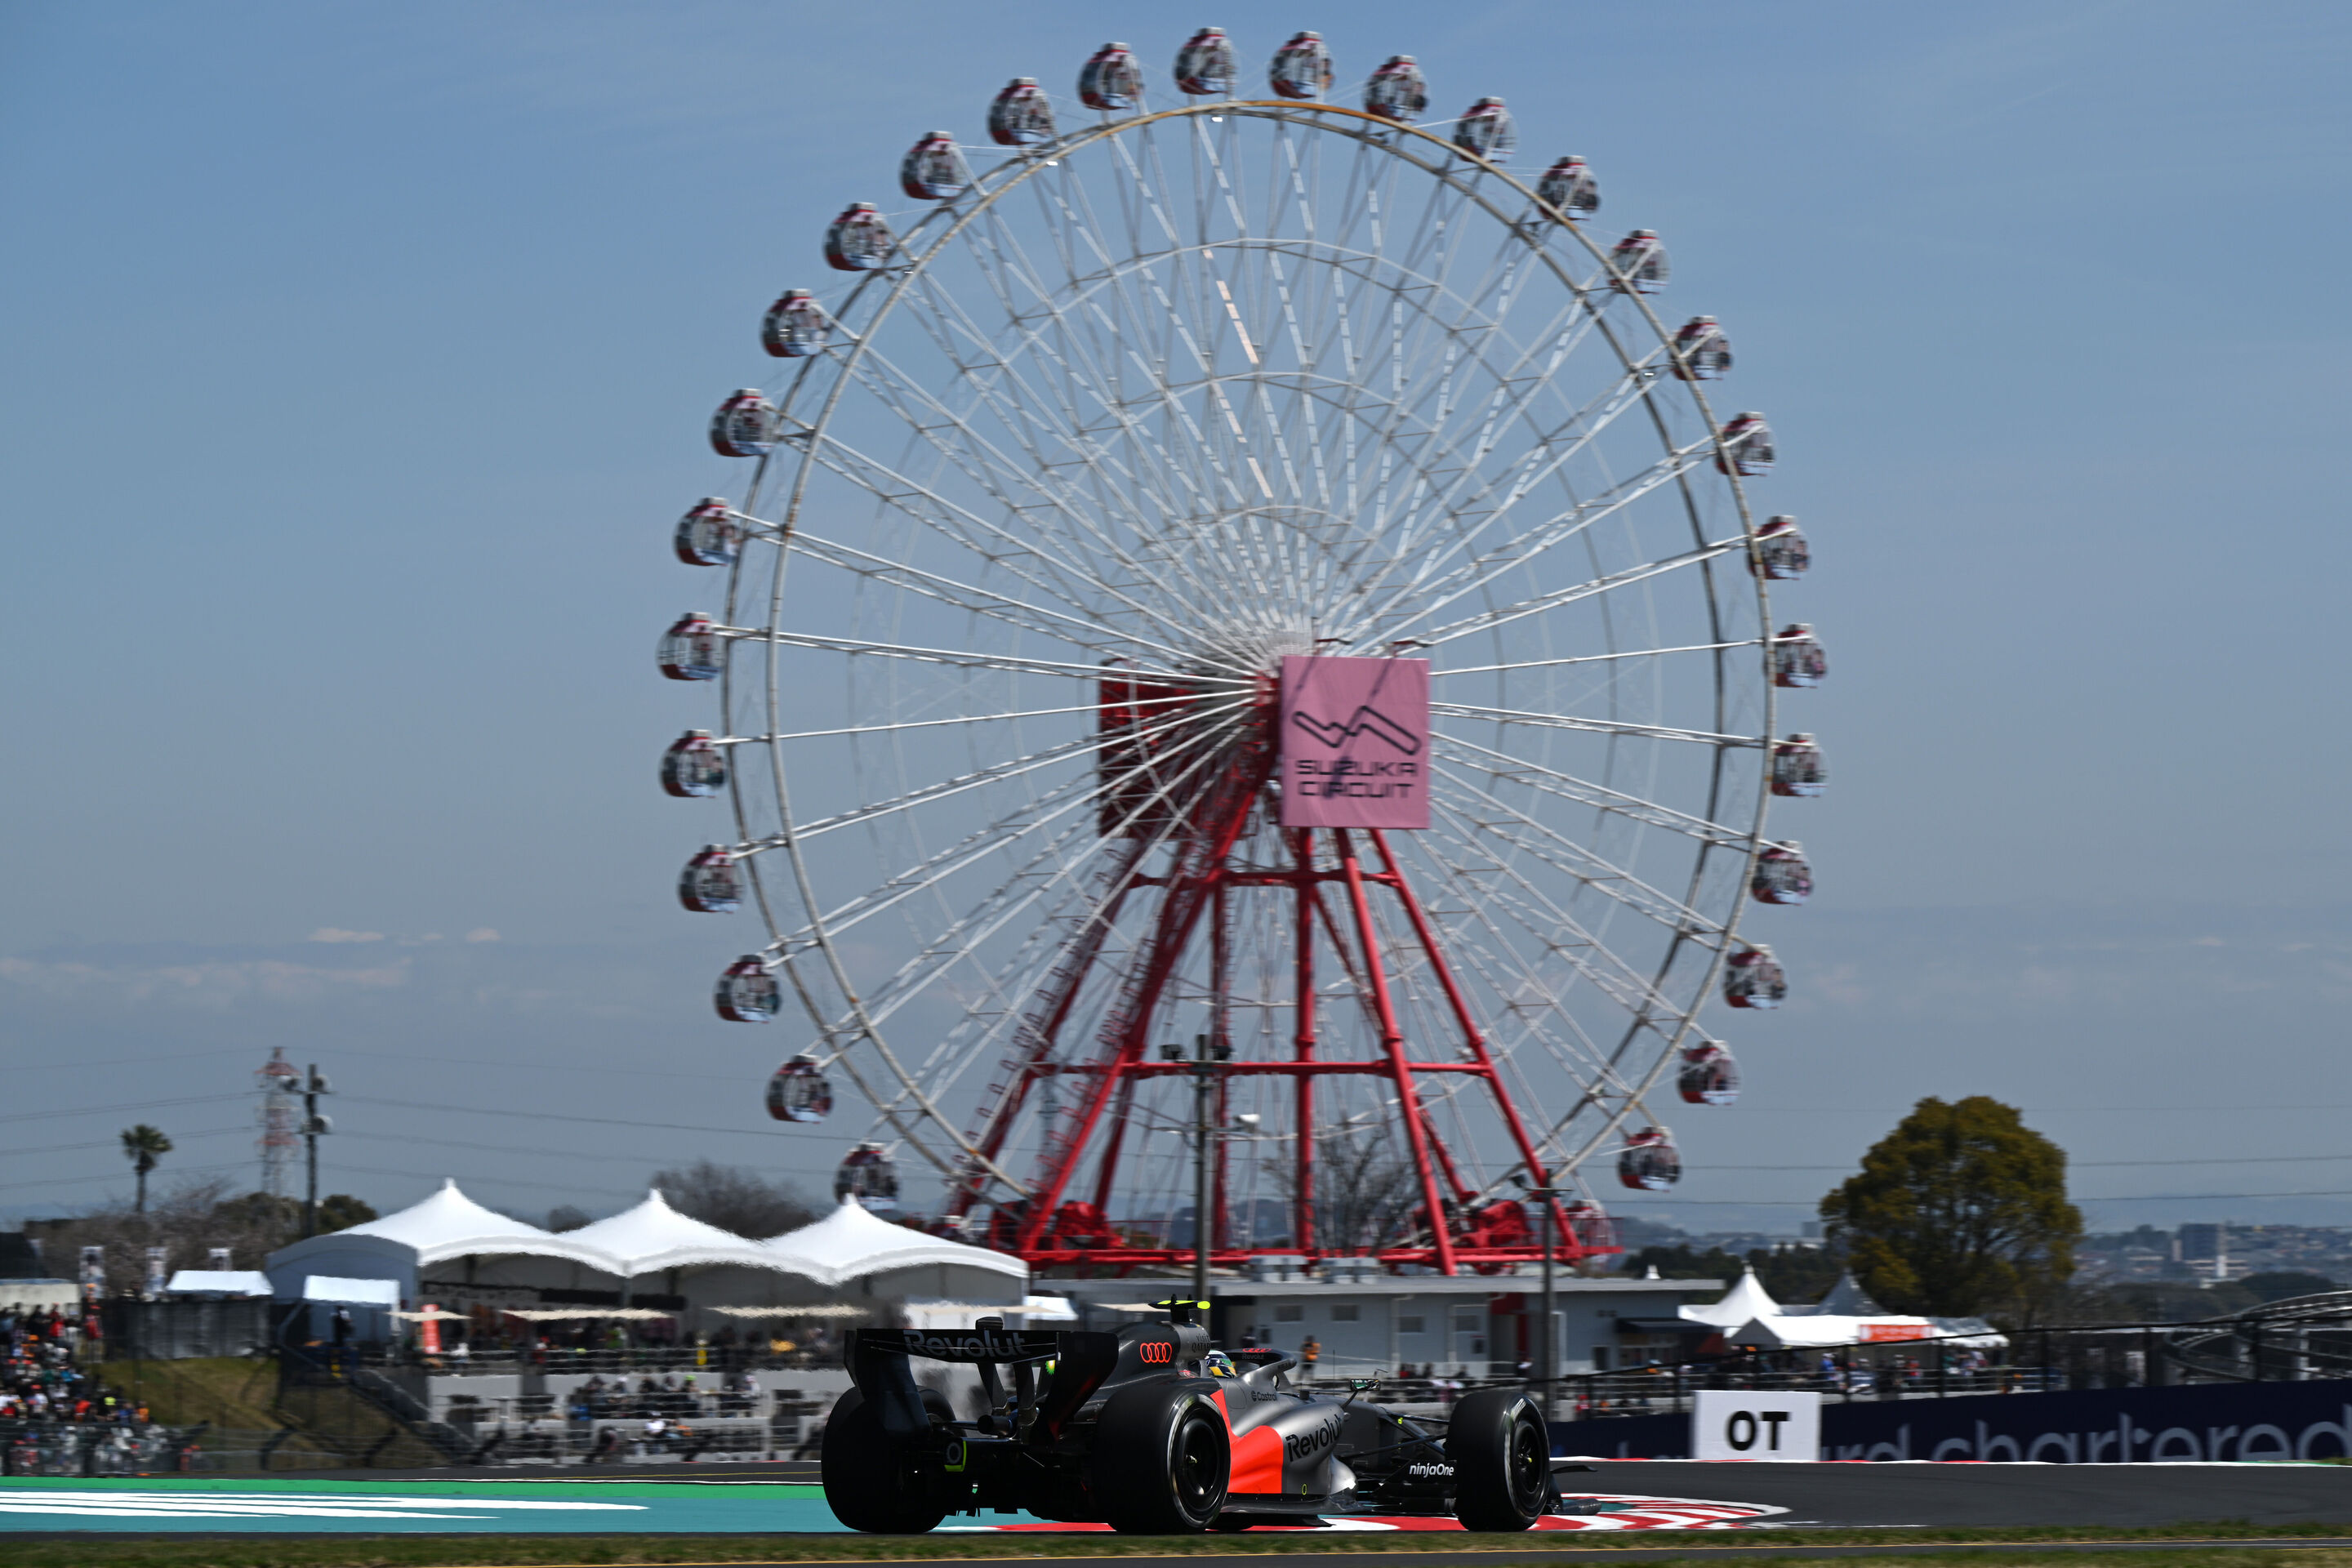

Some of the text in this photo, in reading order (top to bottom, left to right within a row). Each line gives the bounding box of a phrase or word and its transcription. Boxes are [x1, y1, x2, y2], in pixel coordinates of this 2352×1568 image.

[1296, 760, 1419, 777] SUZUKA
[1298, 781, 1414, 798] CIRCUIT
[903, 1330, 1031, 1358] Revolut
[1285, 1414, 1343, 1462] Revolut
[1726, 1410, 1792, 1451] OT
[1409, 1462, 1454, 1478] ninjaOne
